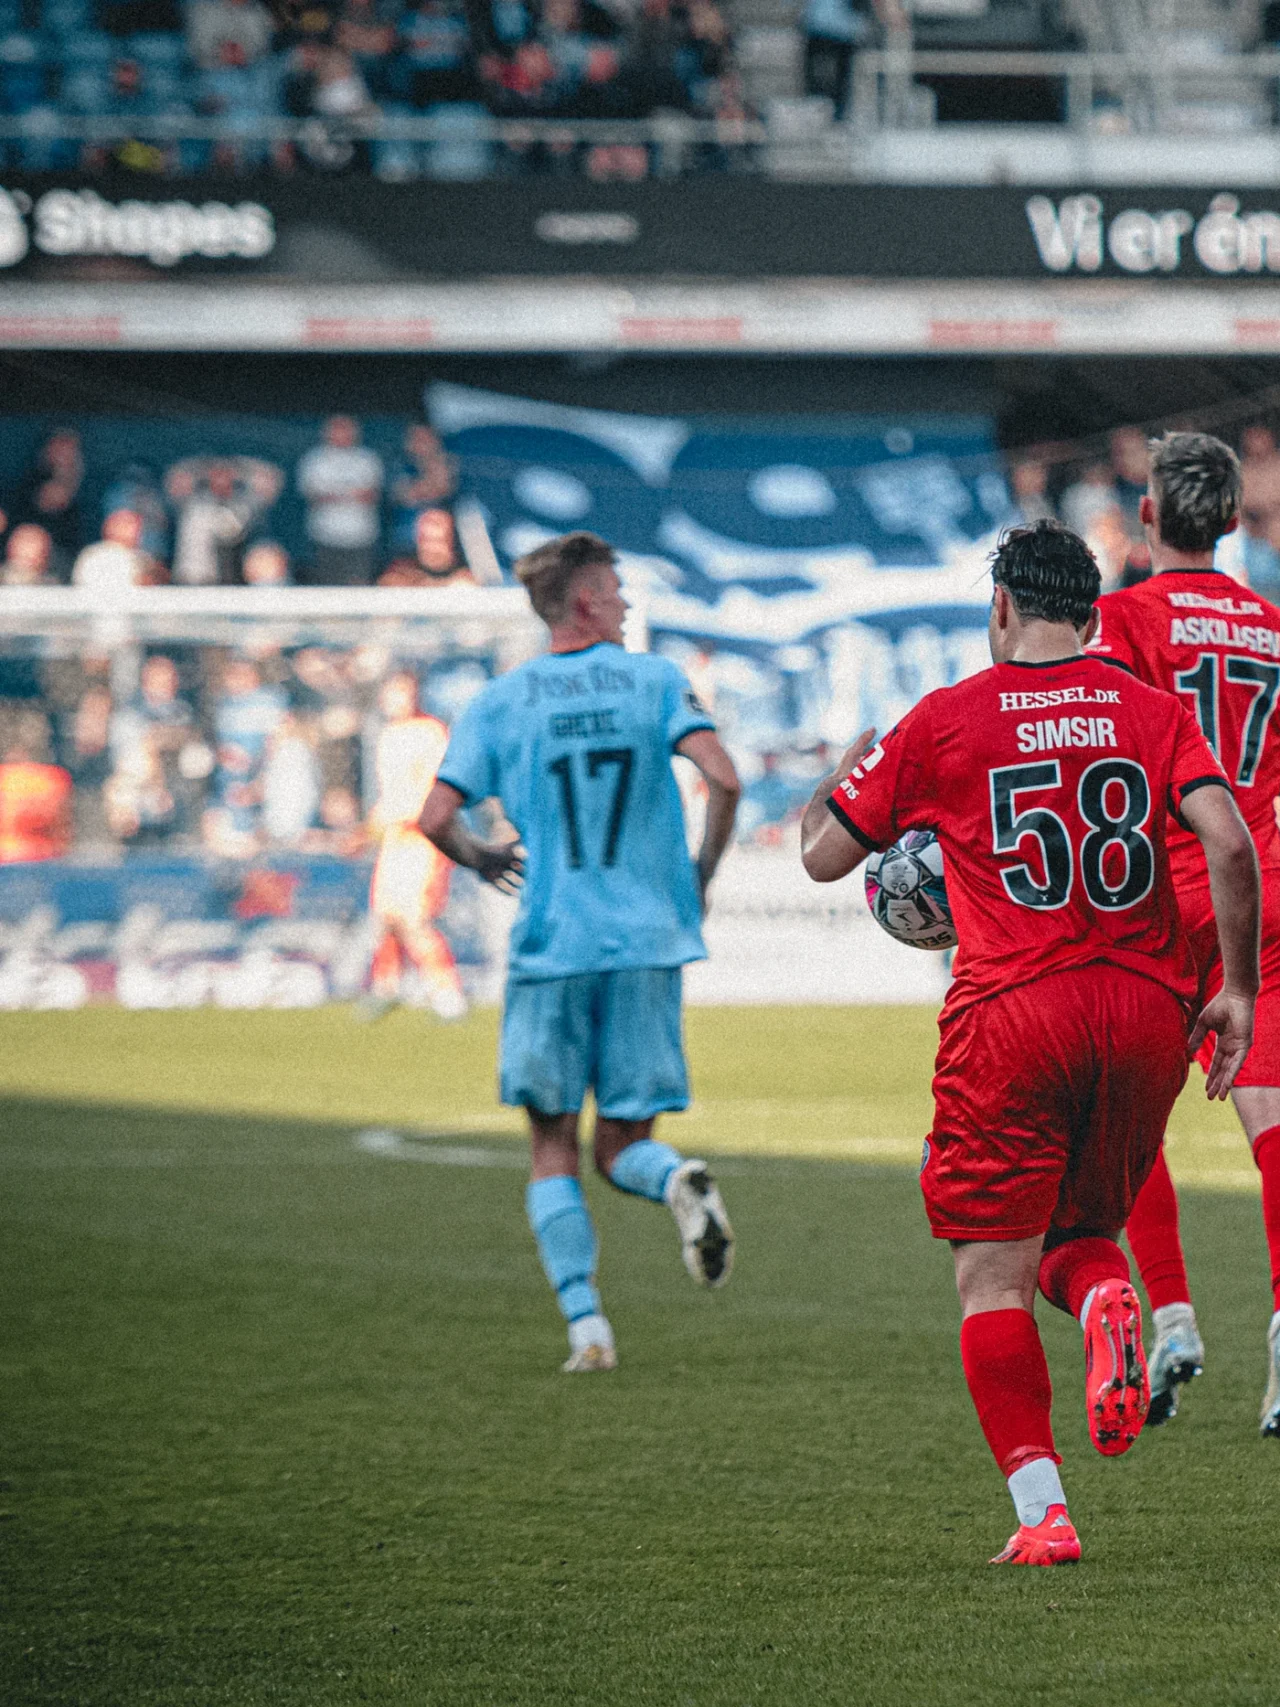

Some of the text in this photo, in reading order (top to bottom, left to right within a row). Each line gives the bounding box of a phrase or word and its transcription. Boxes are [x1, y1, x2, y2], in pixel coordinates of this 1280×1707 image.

[1025, 192, 1102, 273] Vi
[1108, 207, 1194, 273] er
[998, 686, 1122, 712] HESSEL.DK
[1016, 716, 1118, 753] SIMSIR
[547, 747, 635, 870] 17
[988, 757, 1154, 912] 58
